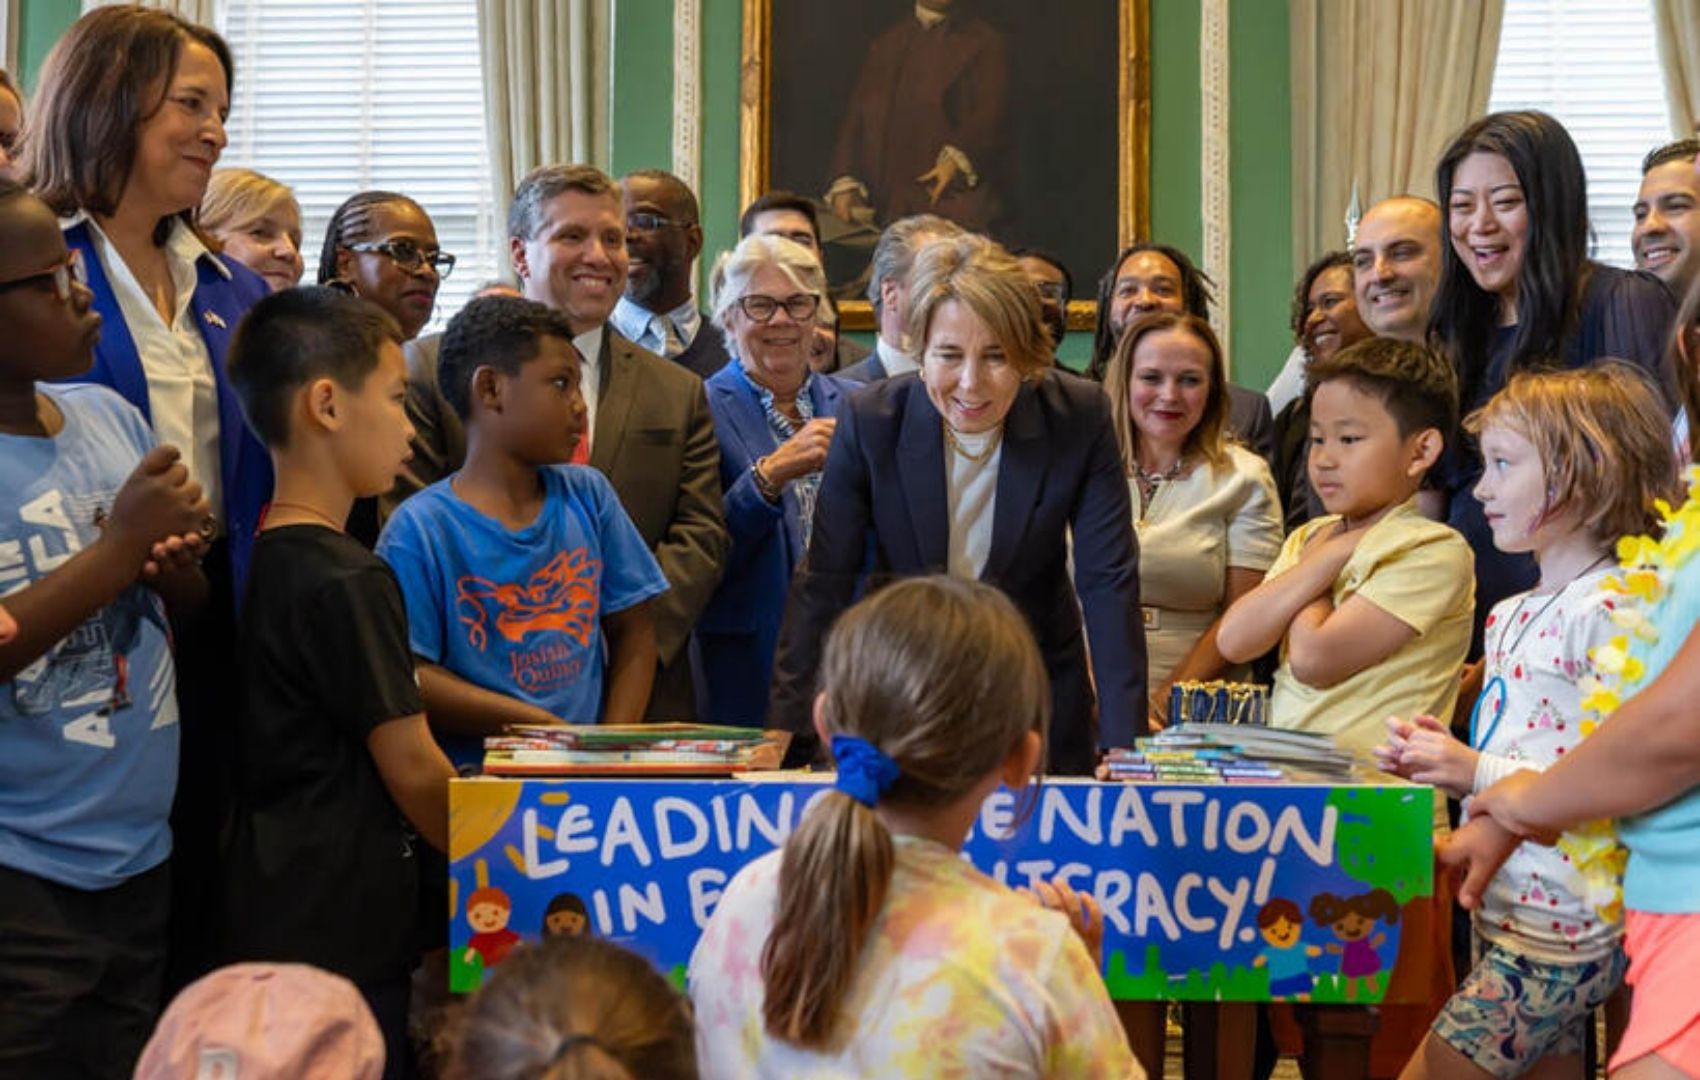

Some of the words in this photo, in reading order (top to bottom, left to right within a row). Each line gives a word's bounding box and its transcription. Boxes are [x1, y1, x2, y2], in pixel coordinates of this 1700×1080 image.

[19, 488, 117, 750] AMECA
[1038, 787, 1339, 867] NATION
[592, 881, 666, 935] IN
